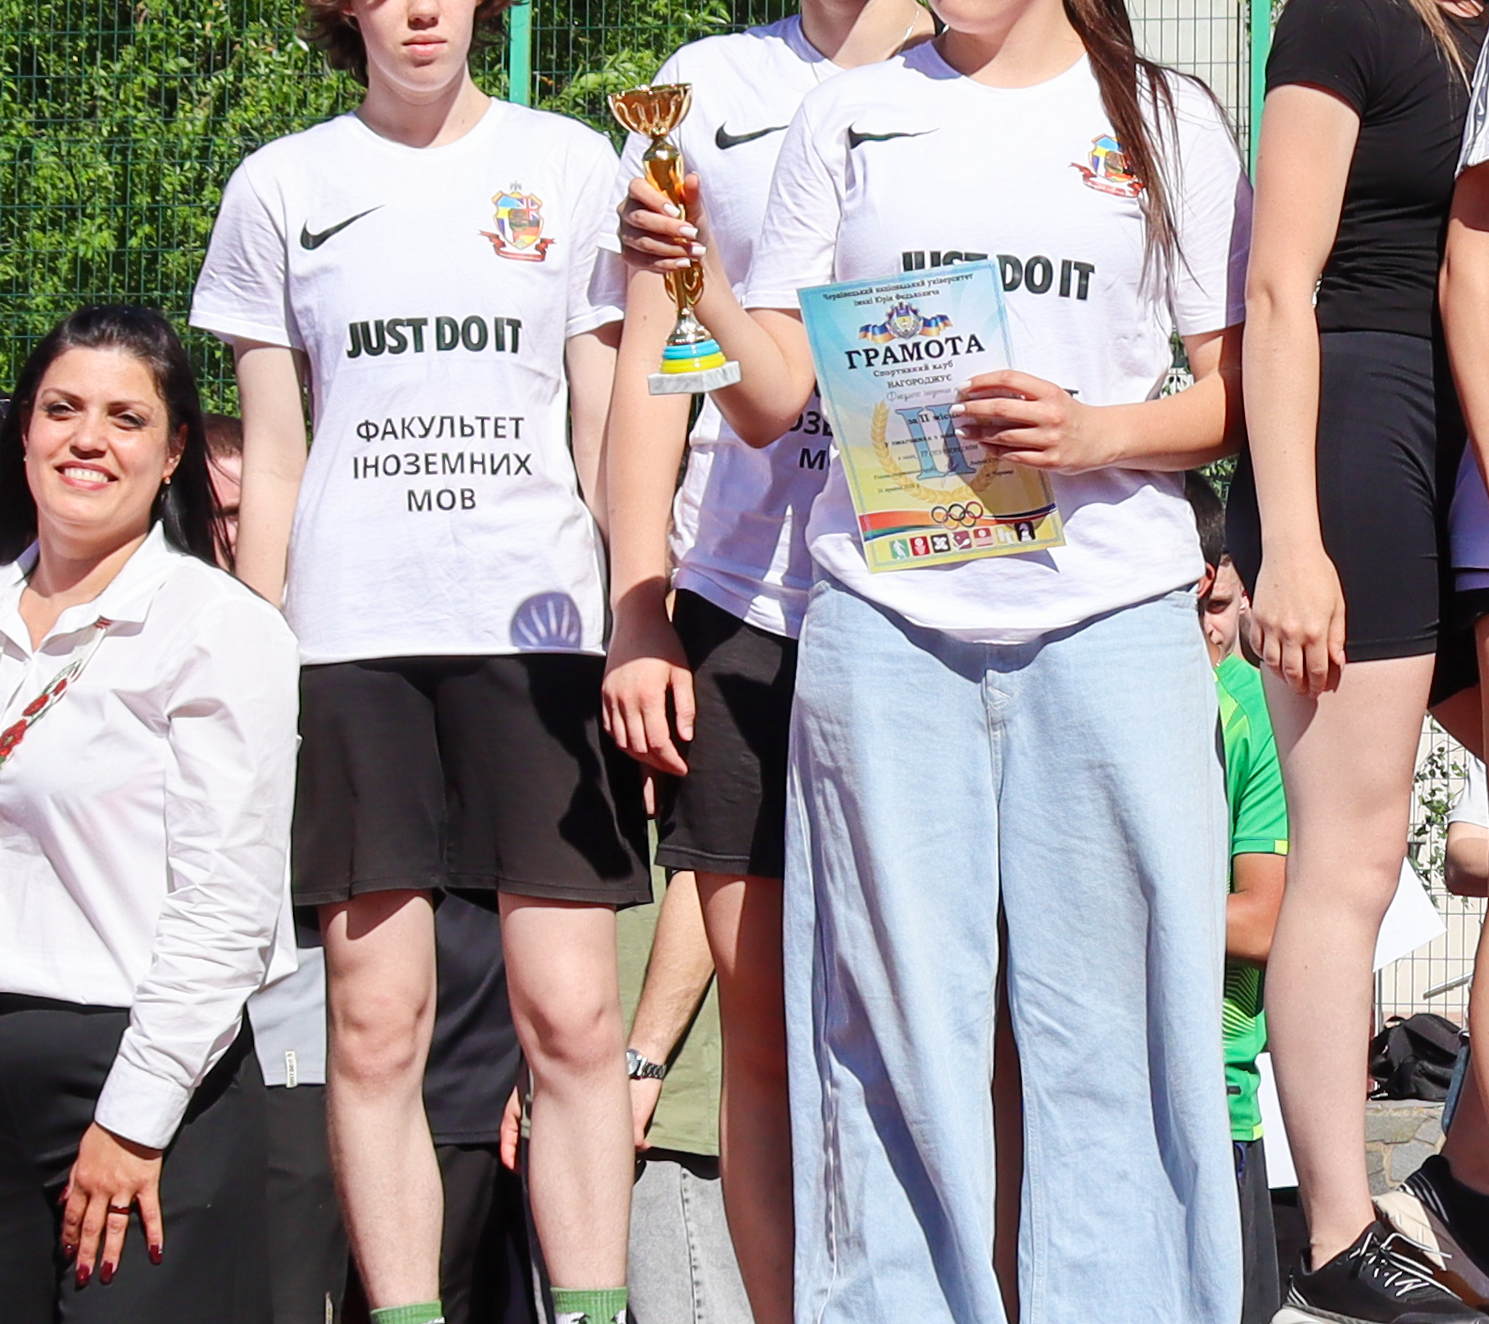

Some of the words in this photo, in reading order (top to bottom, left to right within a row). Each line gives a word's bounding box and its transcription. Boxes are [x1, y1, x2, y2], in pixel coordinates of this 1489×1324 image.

[996, 254, 1054, 295] DO
[1058, 258, 1096, 301] IT
[346, 317, 428, 359] JUST
[435, 315, 488, 352] DO
[494, 316, 523, 354] IT
[845, 334, 985, 370] ГРАМОТА
[932, 360, 954, 372] клуб
[356, 415, 525, 443] ФАКУЛЬТЕТ
[353, 451, 533, 479] ІНОЗЕМНИХ
[407, 488, 476, 512] МОВ
